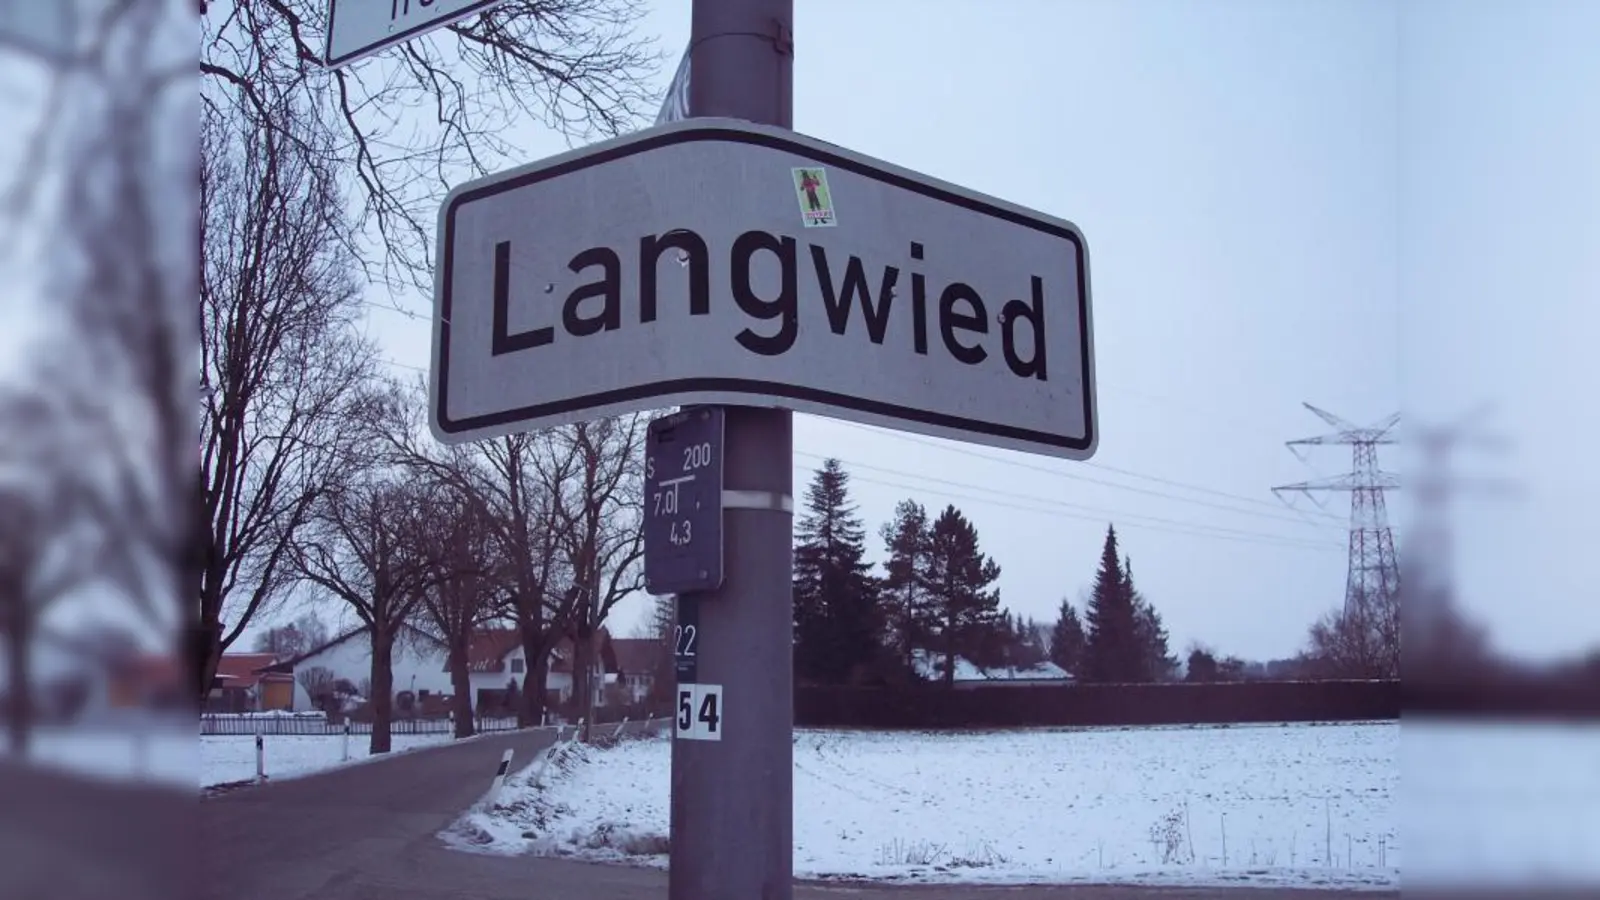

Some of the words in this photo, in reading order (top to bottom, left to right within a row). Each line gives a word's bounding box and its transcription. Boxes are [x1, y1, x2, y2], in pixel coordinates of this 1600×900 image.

[492, 228, 1047, 381] Langwied
[646, 456, 655, 479] S
[683, 442, 711, 471] 200
[674, 624, 696, 656] 22
[679, 691, 719, 733] 54
